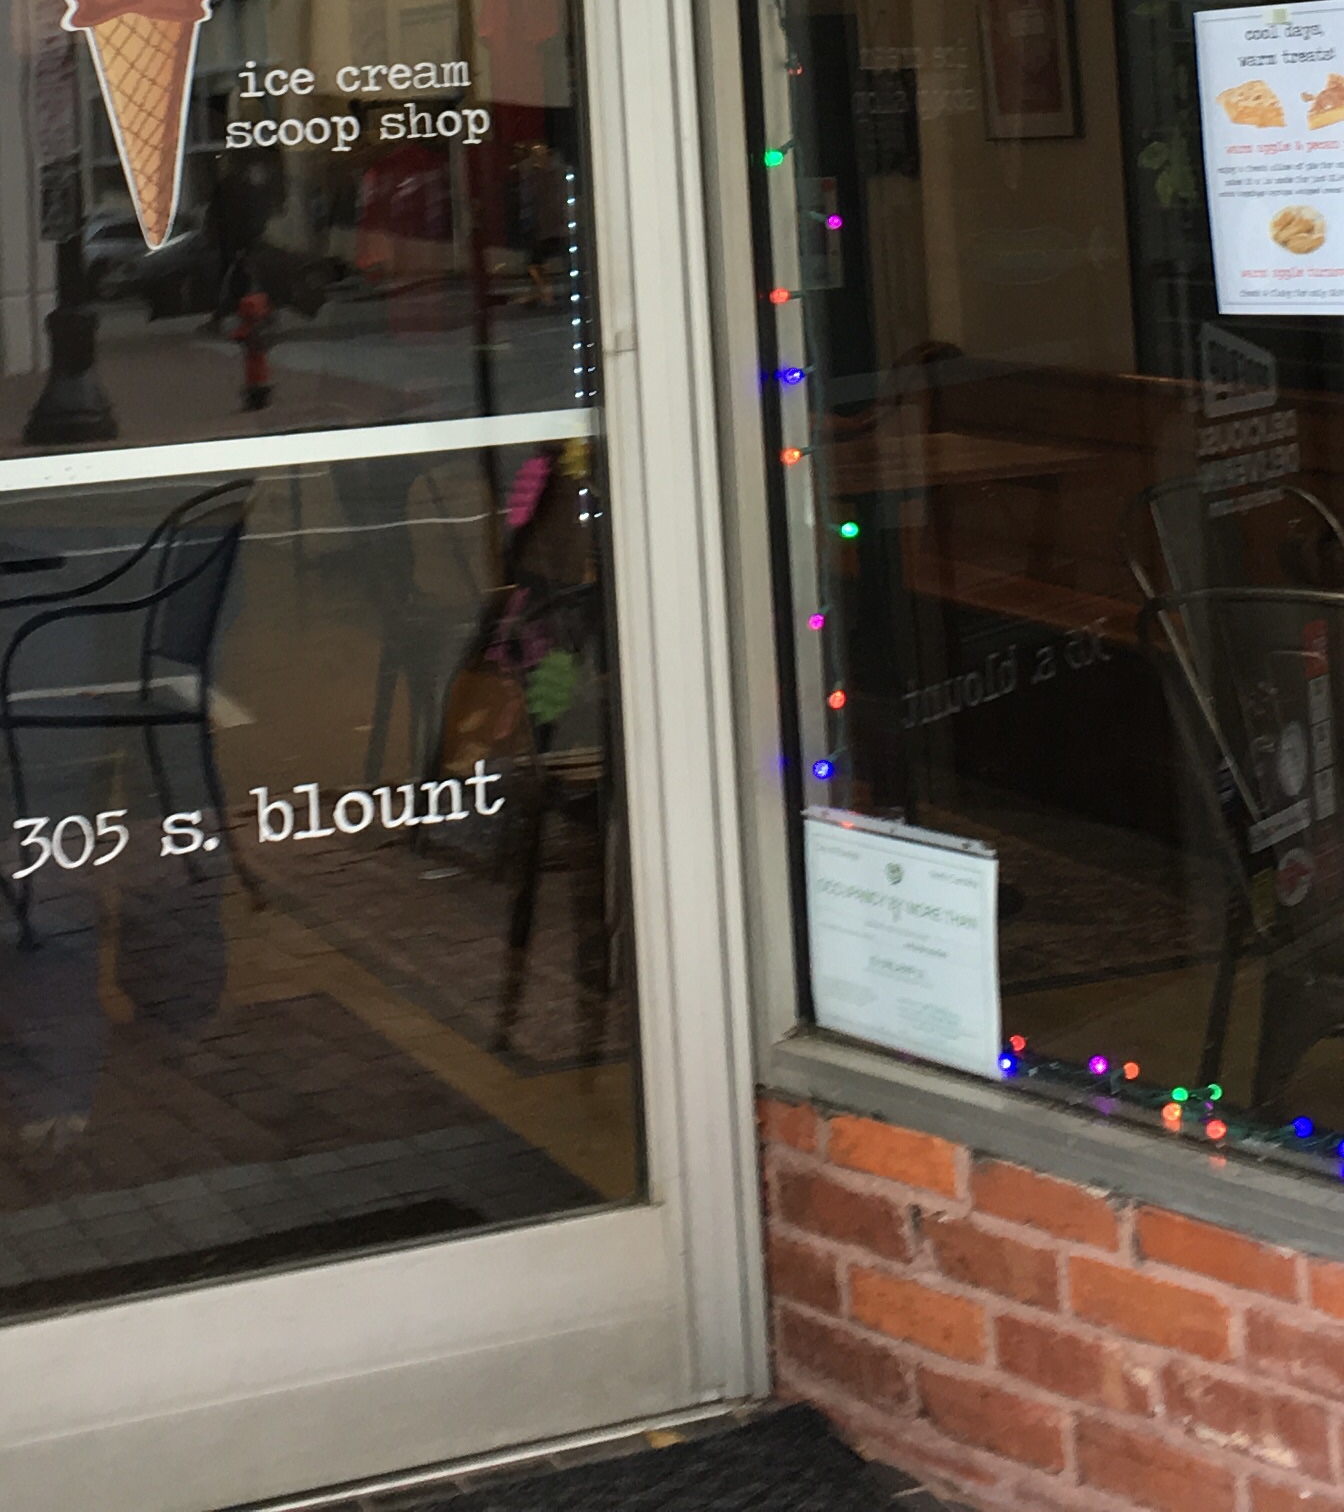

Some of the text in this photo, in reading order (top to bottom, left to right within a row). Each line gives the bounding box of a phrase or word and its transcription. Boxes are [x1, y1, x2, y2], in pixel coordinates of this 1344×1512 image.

[238, 59, 473, 100] ice cream
[225, 101, 491, 153] scoop shop
[11, 758, 506, 880] 305 s. blount
